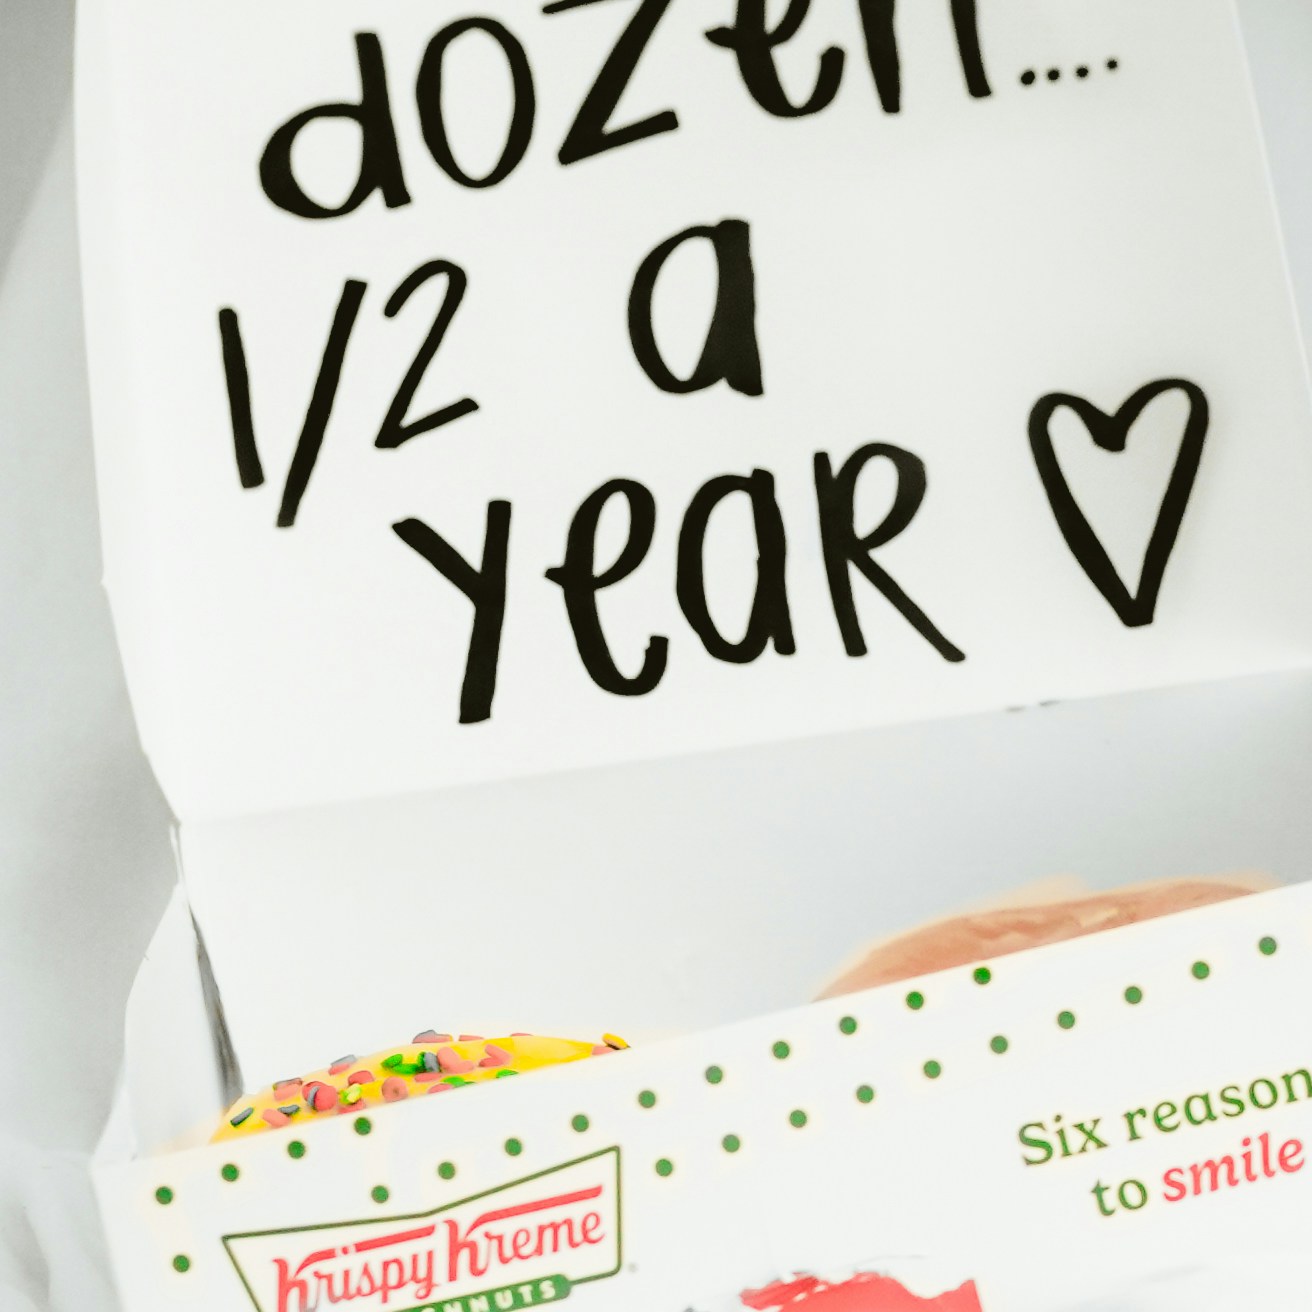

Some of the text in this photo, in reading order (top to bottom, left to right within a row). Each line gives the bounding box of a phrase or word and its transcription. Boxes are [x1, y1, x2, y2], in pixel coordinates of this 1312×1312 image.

[219, 219, 764, 528] 1/2 a
[1018, 1117, 1108, 1166] Six
[1091, 1132, 1305, 1216] to smile
[273, 1185, 604, 1312] Krispy Kreme
